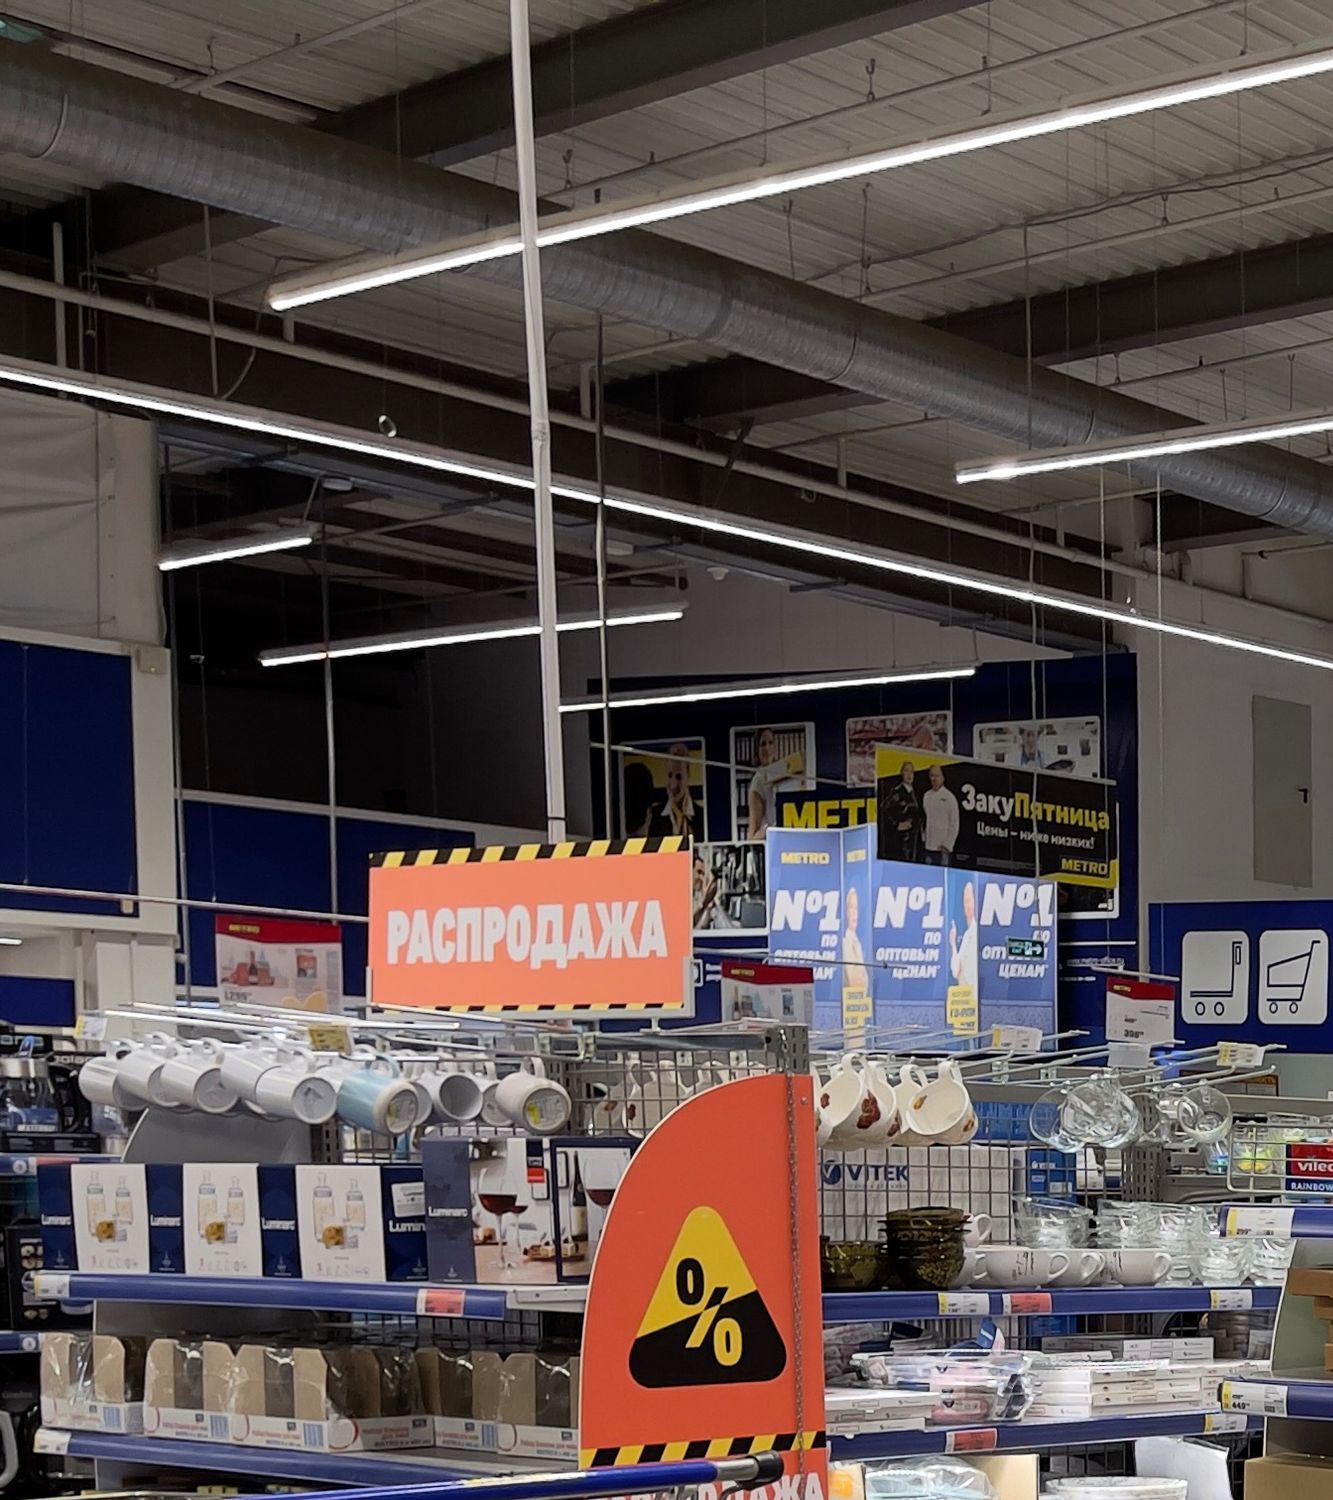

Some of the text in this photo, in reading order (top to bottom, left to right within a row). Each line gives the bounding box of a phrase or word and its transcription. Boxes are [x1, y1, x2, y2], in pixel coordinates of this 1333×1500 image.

[782, 799, 878, 829] MET
[960, 783, 1110, 831] ЗакуПятница
[976, 821, 1008, 838] Цены
[1051, 833, 1095, 850] низких!
[1062, 858, 1107, 874] METRO
[387, 899, 668, 970] РАСПРОДАЖА
[821, 934, 839, 947] ПО
[924, 931, 941, 945] ПО
[876, 948, 940, 962] ОПТОВЫМ
[846, 1164, 908, 1182] VITEK
[389, 1218, 427, 1233] Lumin
